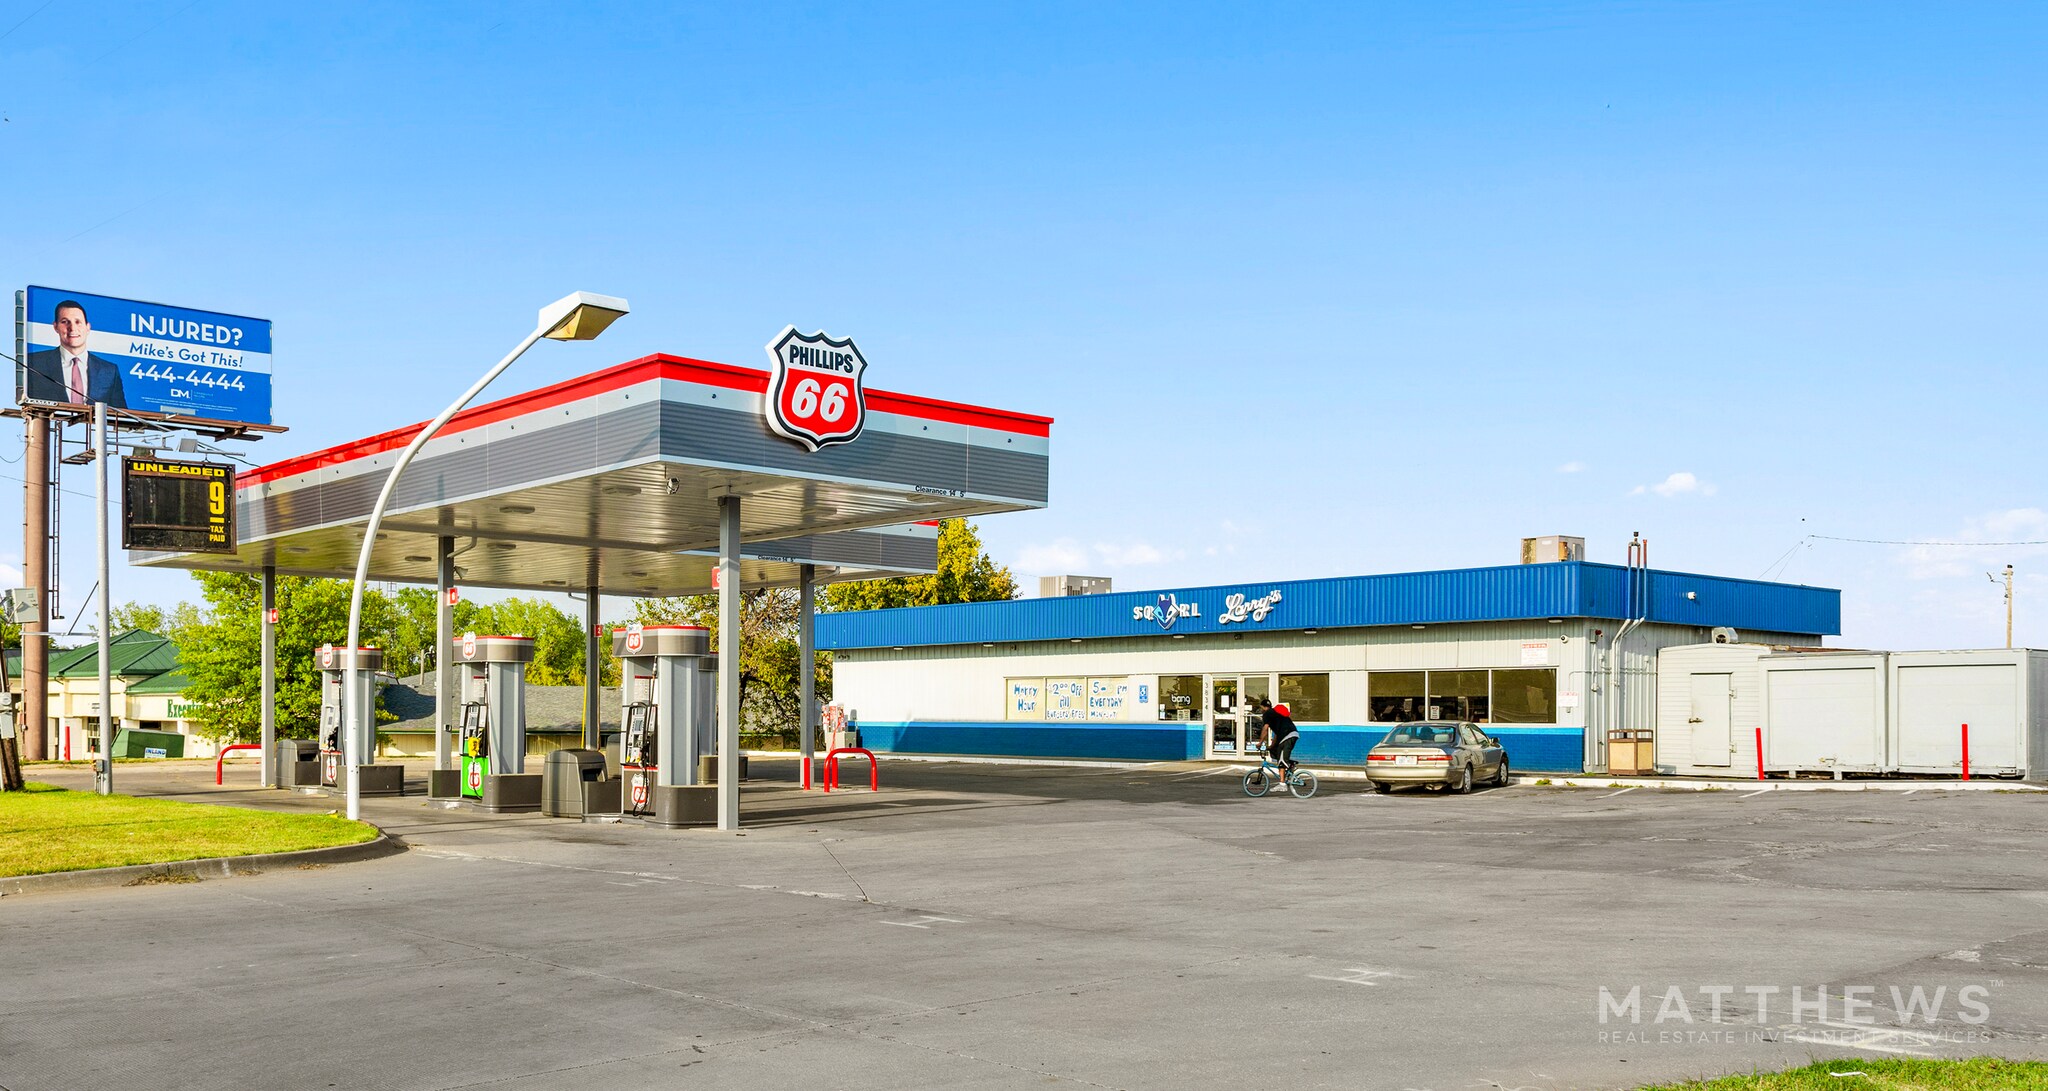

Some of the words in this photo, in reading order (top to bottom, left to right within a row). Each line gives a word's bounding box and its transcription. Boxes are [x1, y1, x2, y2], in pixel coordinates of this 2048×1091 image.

[131, 313, 243, 346] INJURED?
[129, 342, 174, 359] Mike's
[178, 348, 205, 363] Got
[211, 352, 243, 368] This!
[789, 344, 854, 373] PHILLIPS
[129, 362, 245, 392] 444-4444
[791, 378, 849, 422] 66
[133, 462, 225, 477] UNLEADED
[209, 481, 225, 515] 9
[915, 484, 947, 496] Clearance
[209, 534, 225, 542] PAID
[210, 525, 224, 534] TAX
[1219, 590, 1282, 624] Larry's
[628, 633, 641, 647] 66
[1171, 694, 1191, 705] bang
